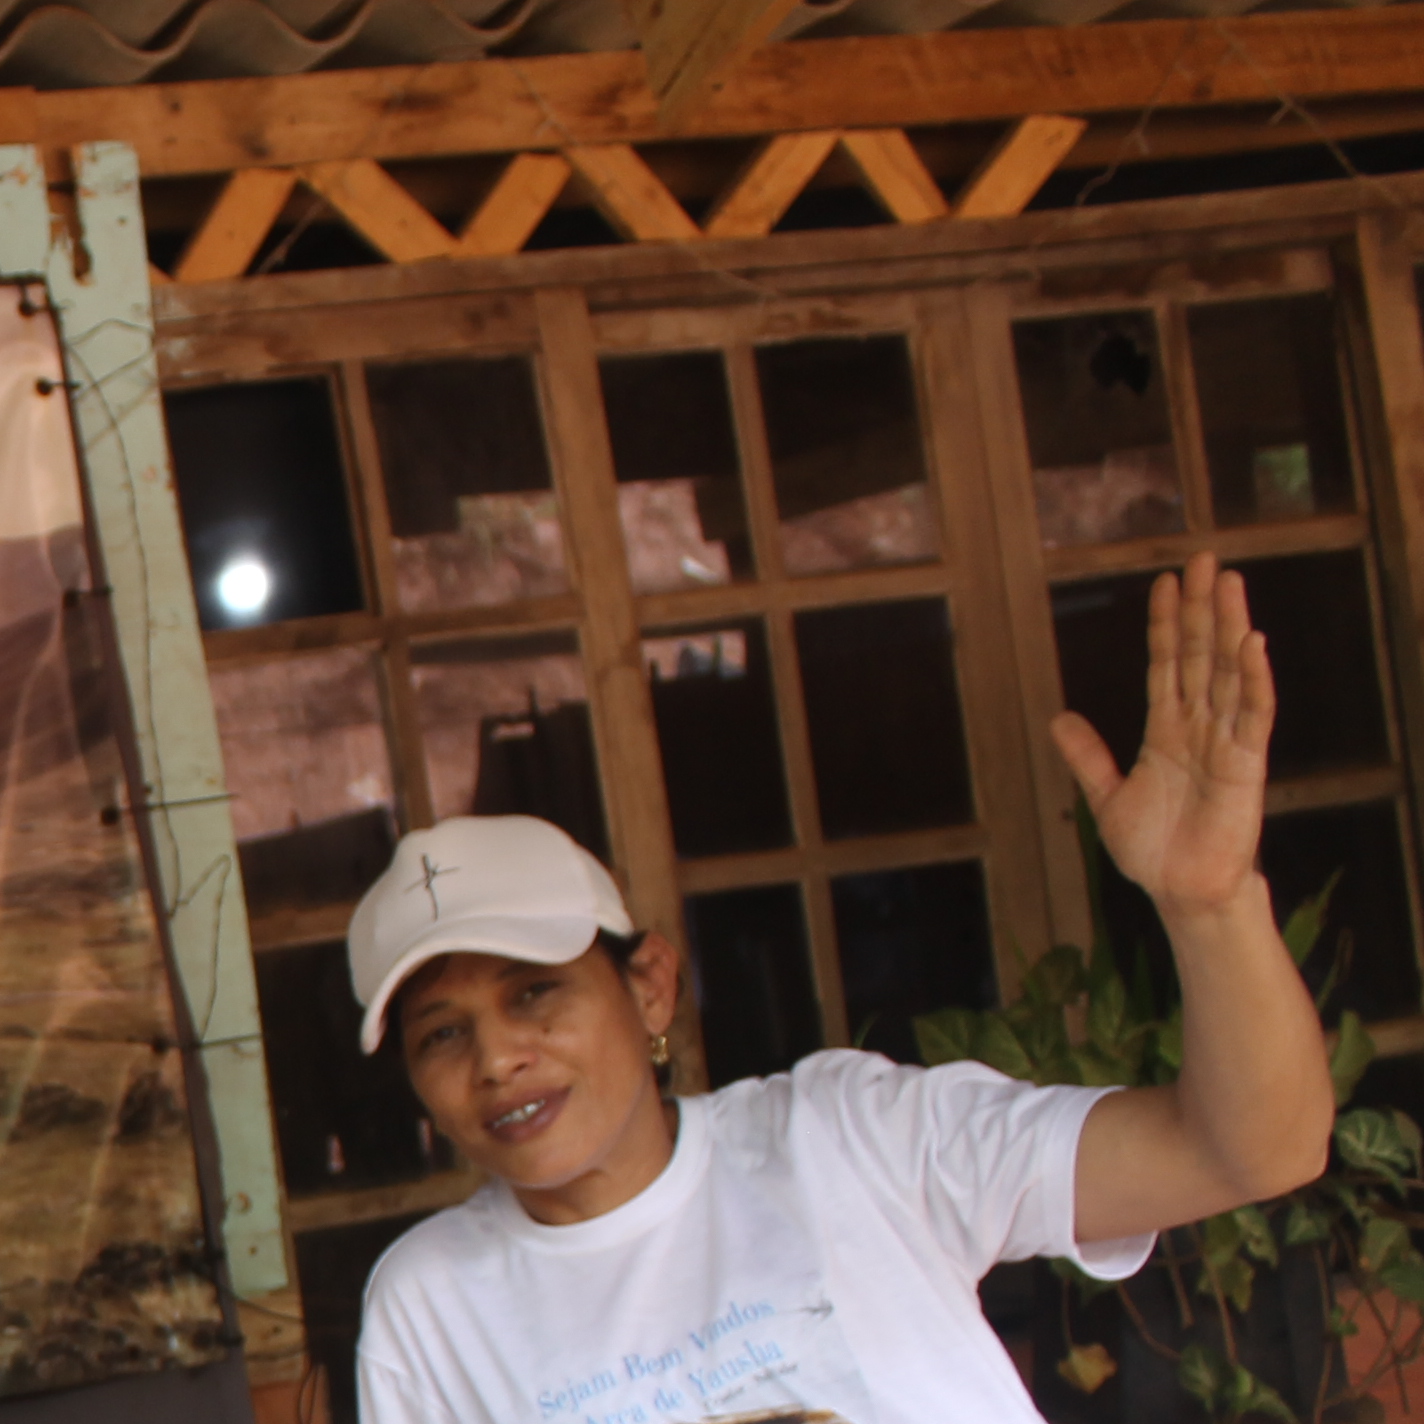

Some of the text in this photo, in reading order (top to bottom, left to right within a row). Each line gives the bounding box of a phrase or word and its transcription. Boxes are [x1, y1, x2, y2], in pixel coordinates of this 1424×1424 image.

[539, 1370, 617, 1419] Sejam
[623, 1348, 684, 1382] Bem
[655, 1387, 684, 1412] de
